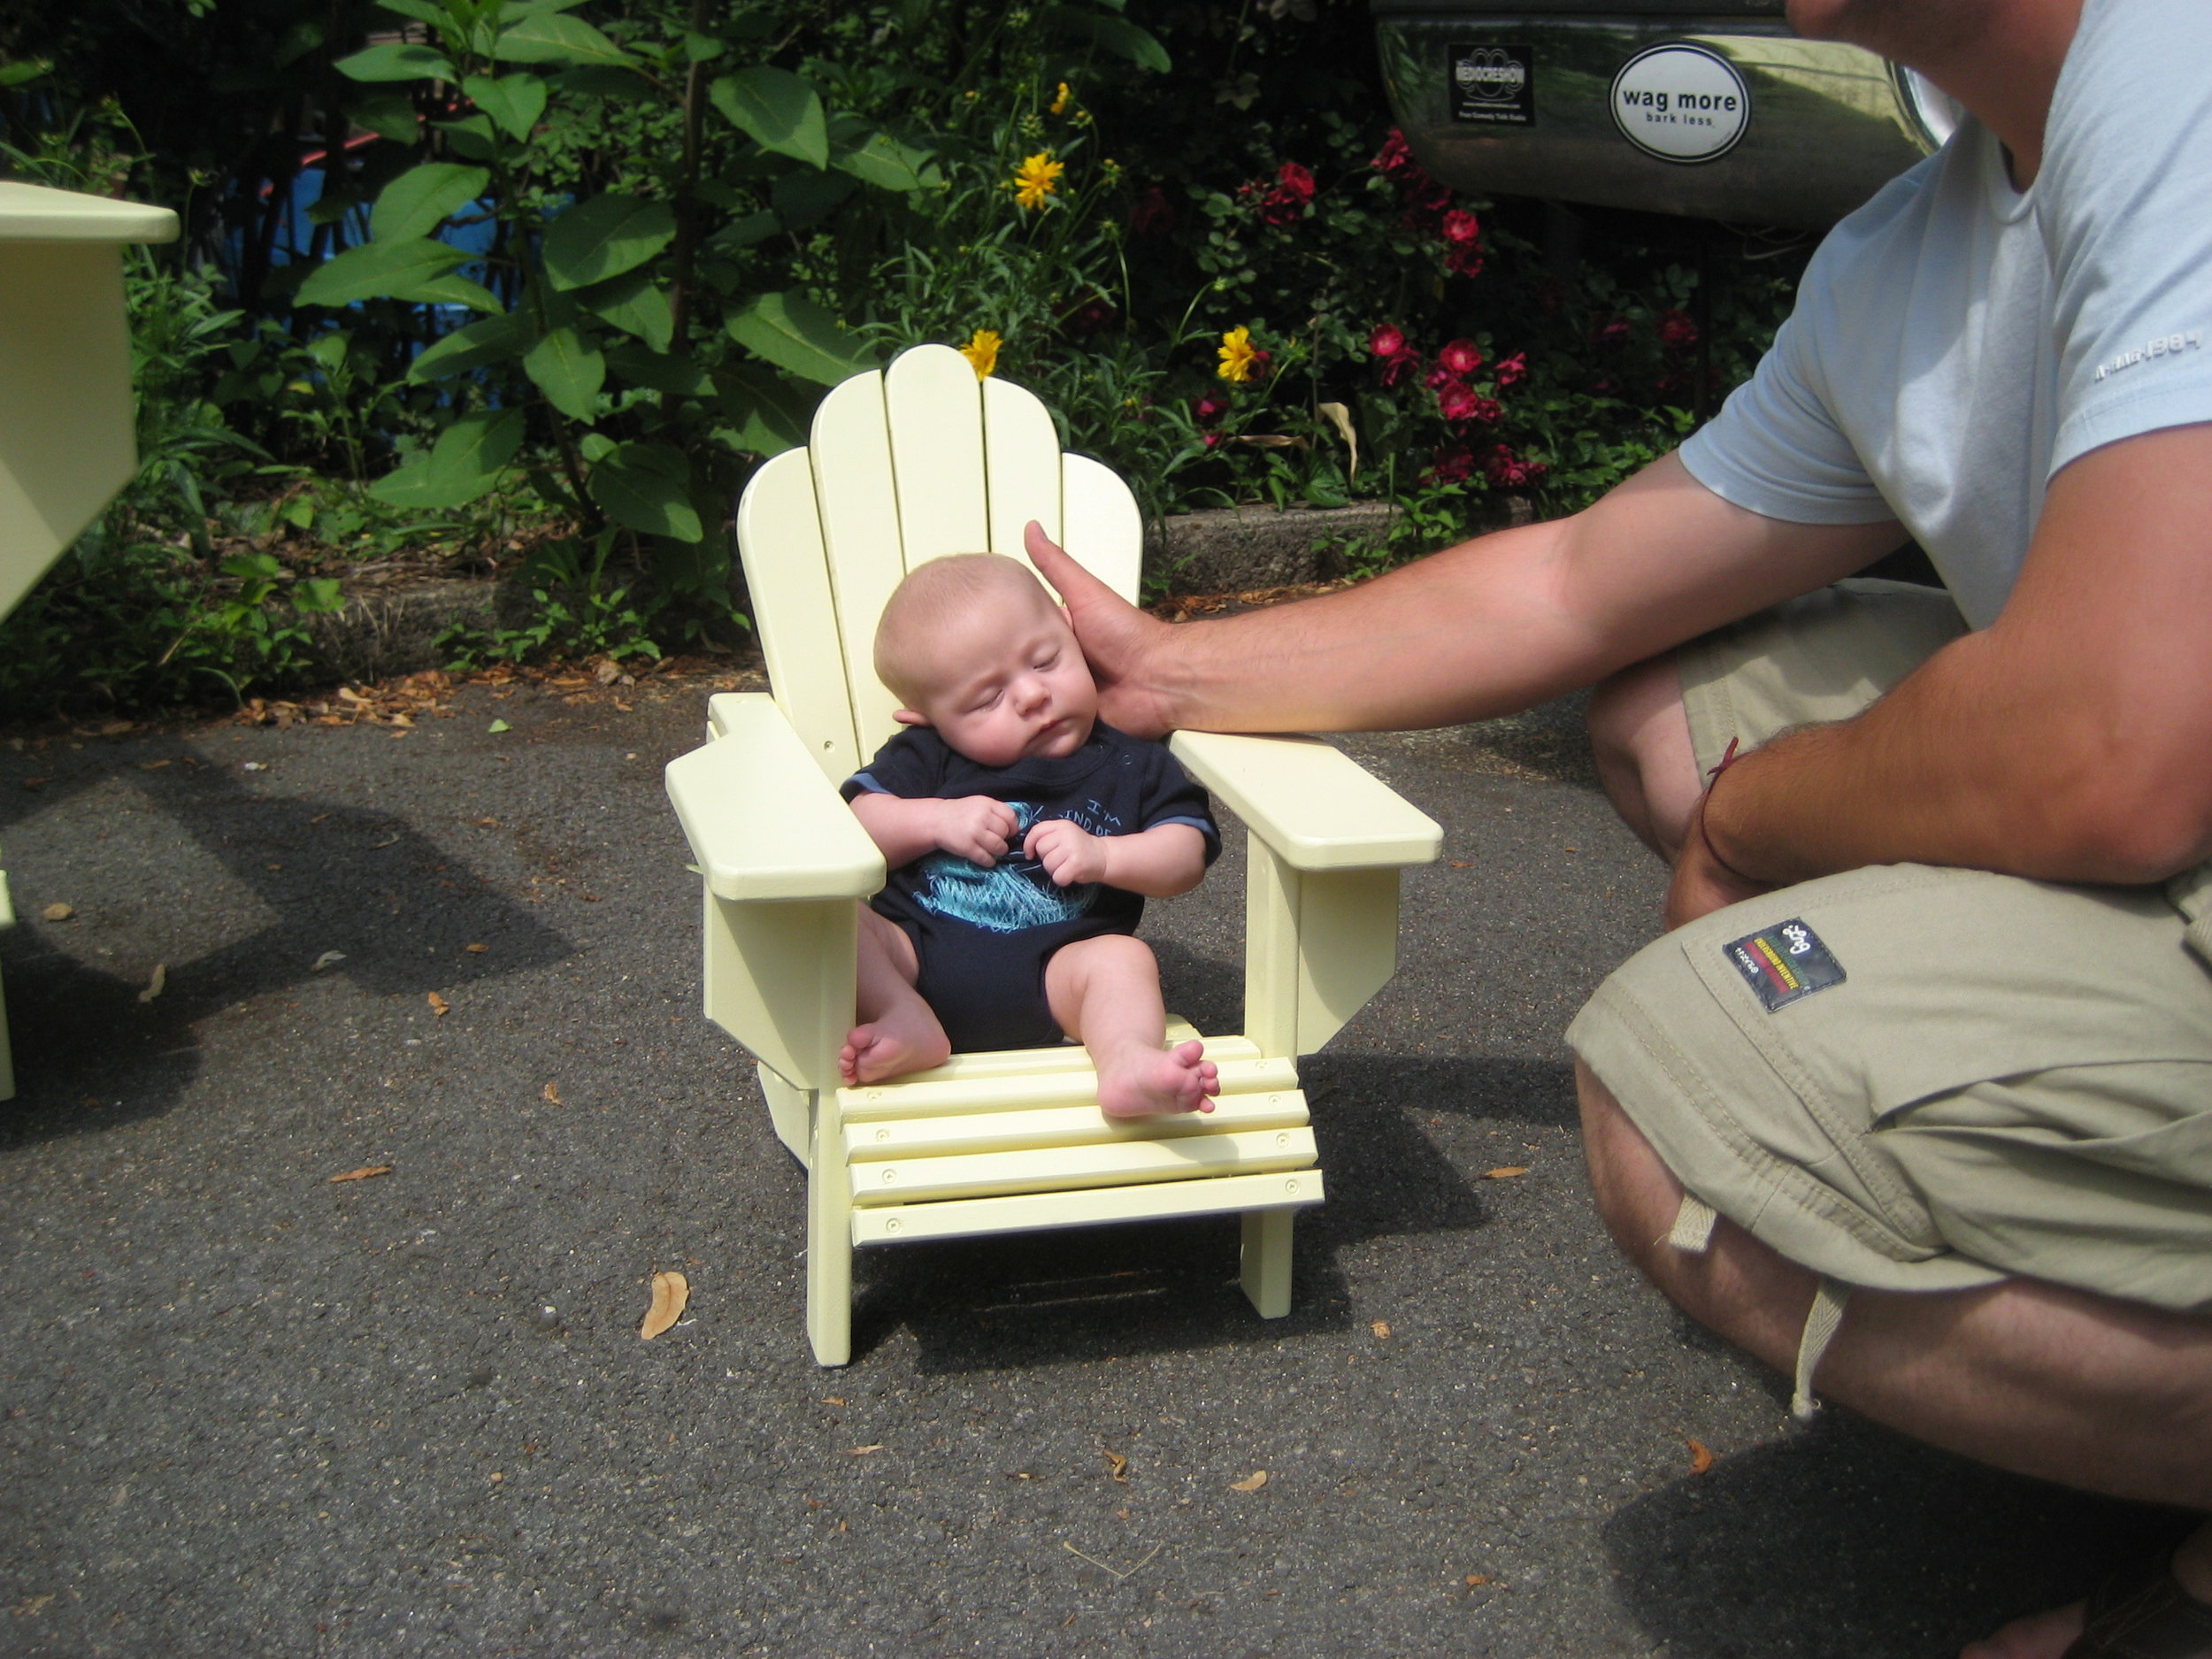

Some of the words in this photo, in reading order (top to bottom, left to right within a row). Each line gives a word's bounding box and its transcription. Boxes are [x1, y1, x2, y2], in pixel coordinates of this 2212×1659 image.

[1623, 90, 1668, 112] wag
[1678, 93, 1737, 111] more
[1646, 112, 1677, 124] bark
[1683, 114, 1713, 126] less
